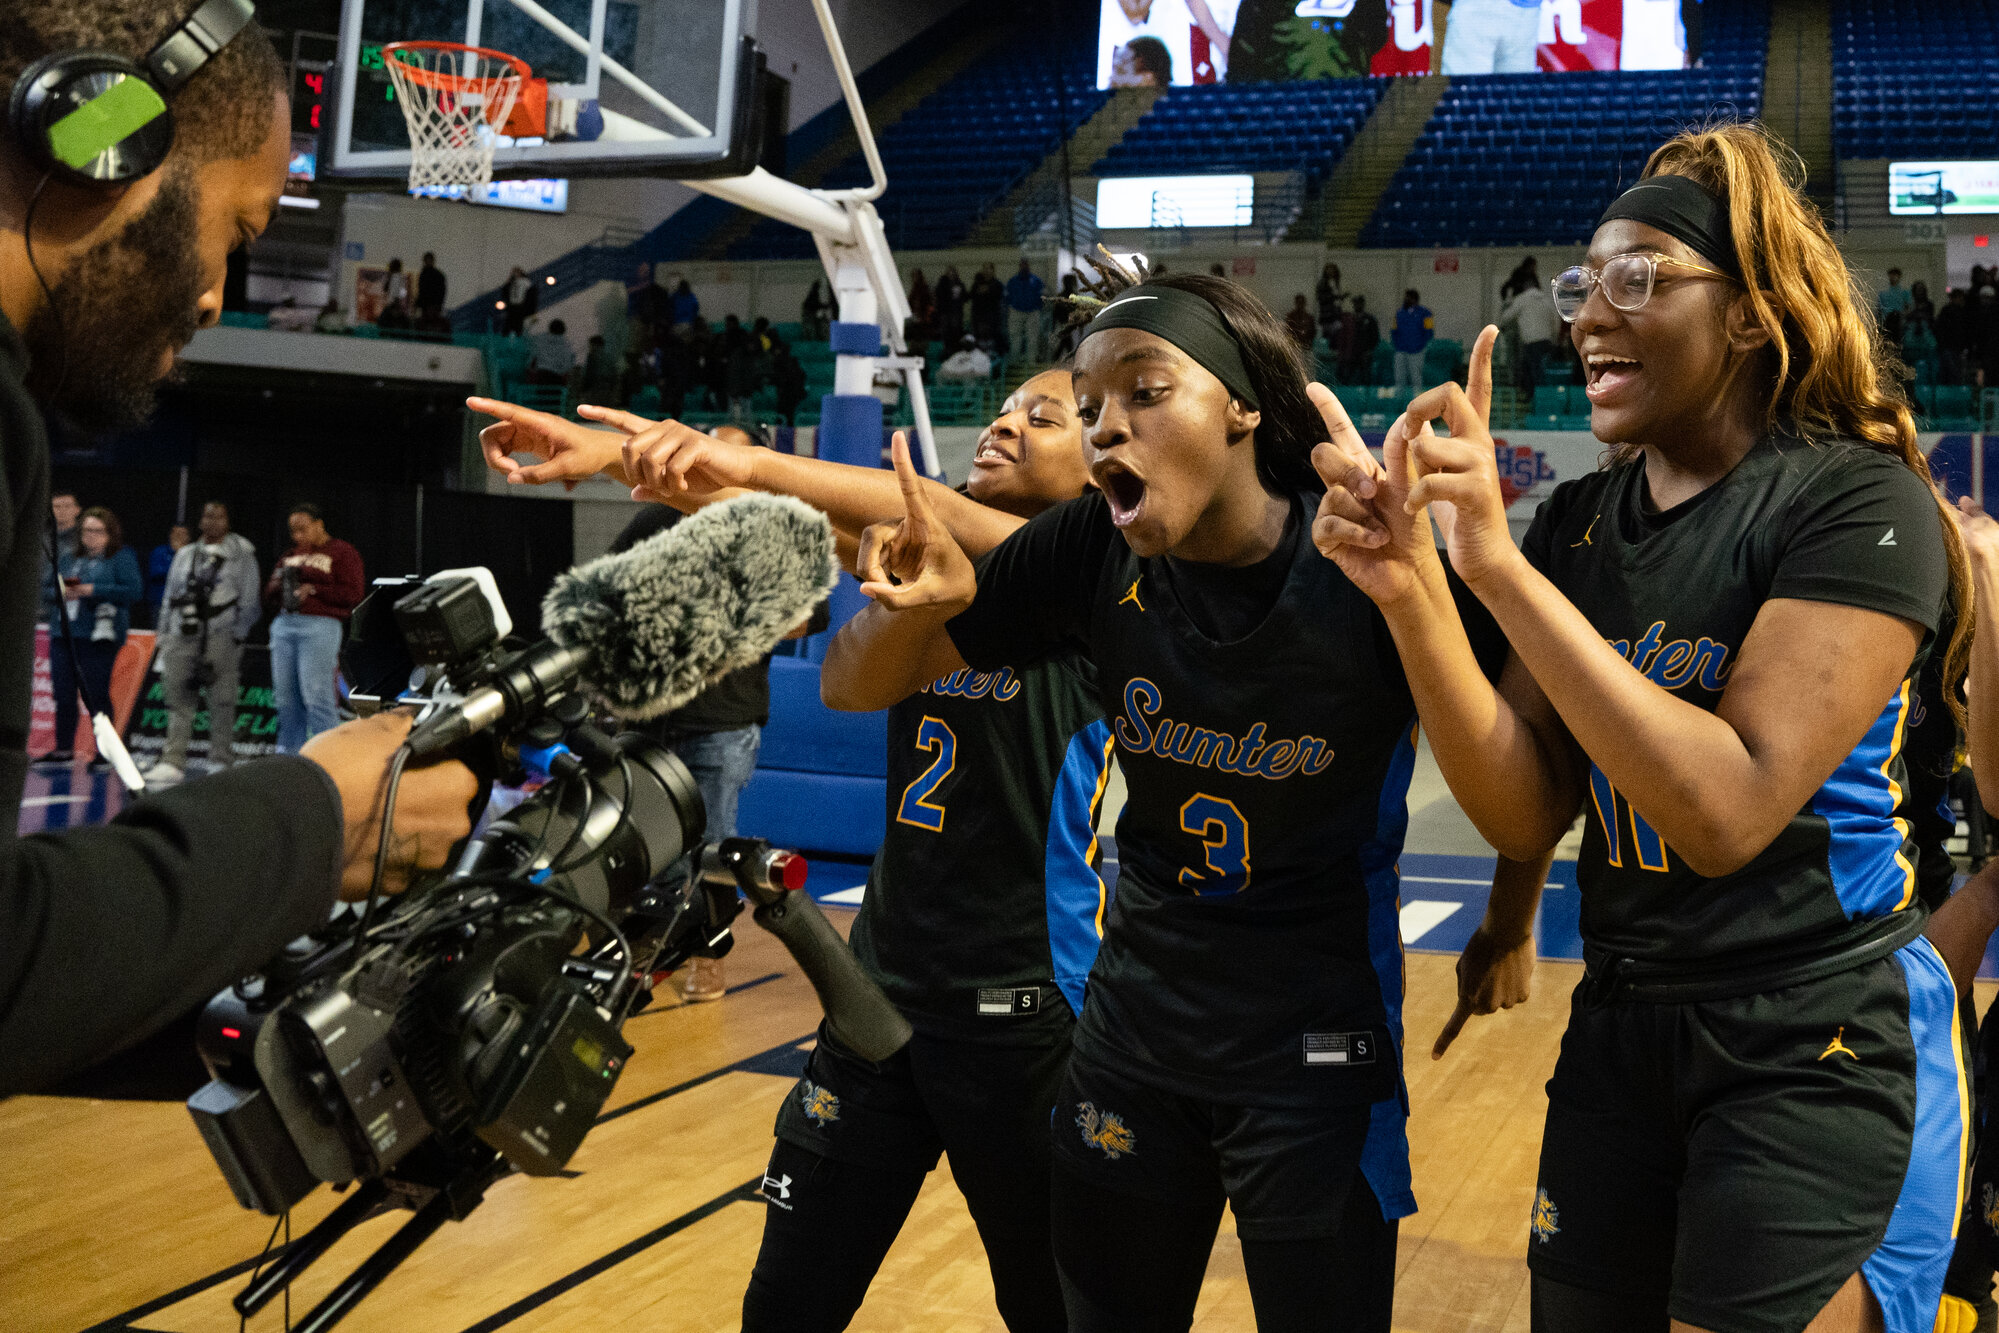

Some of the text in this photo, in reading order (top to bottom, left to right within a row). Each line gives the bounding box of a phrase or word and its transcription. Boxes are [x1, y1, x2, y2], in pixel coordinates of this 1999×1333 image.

[1495, 447, 1556, 487] HSL
[1605, 620, 1736, 691] ter
[1115, 677, 1335, 780] Sumter
[897, 714, 957, 832] 2
[1178, 792, 1251, 897] 3
[1021, 994, 1031, 1008] S
[1357, 1040, 1367, 1055] S
